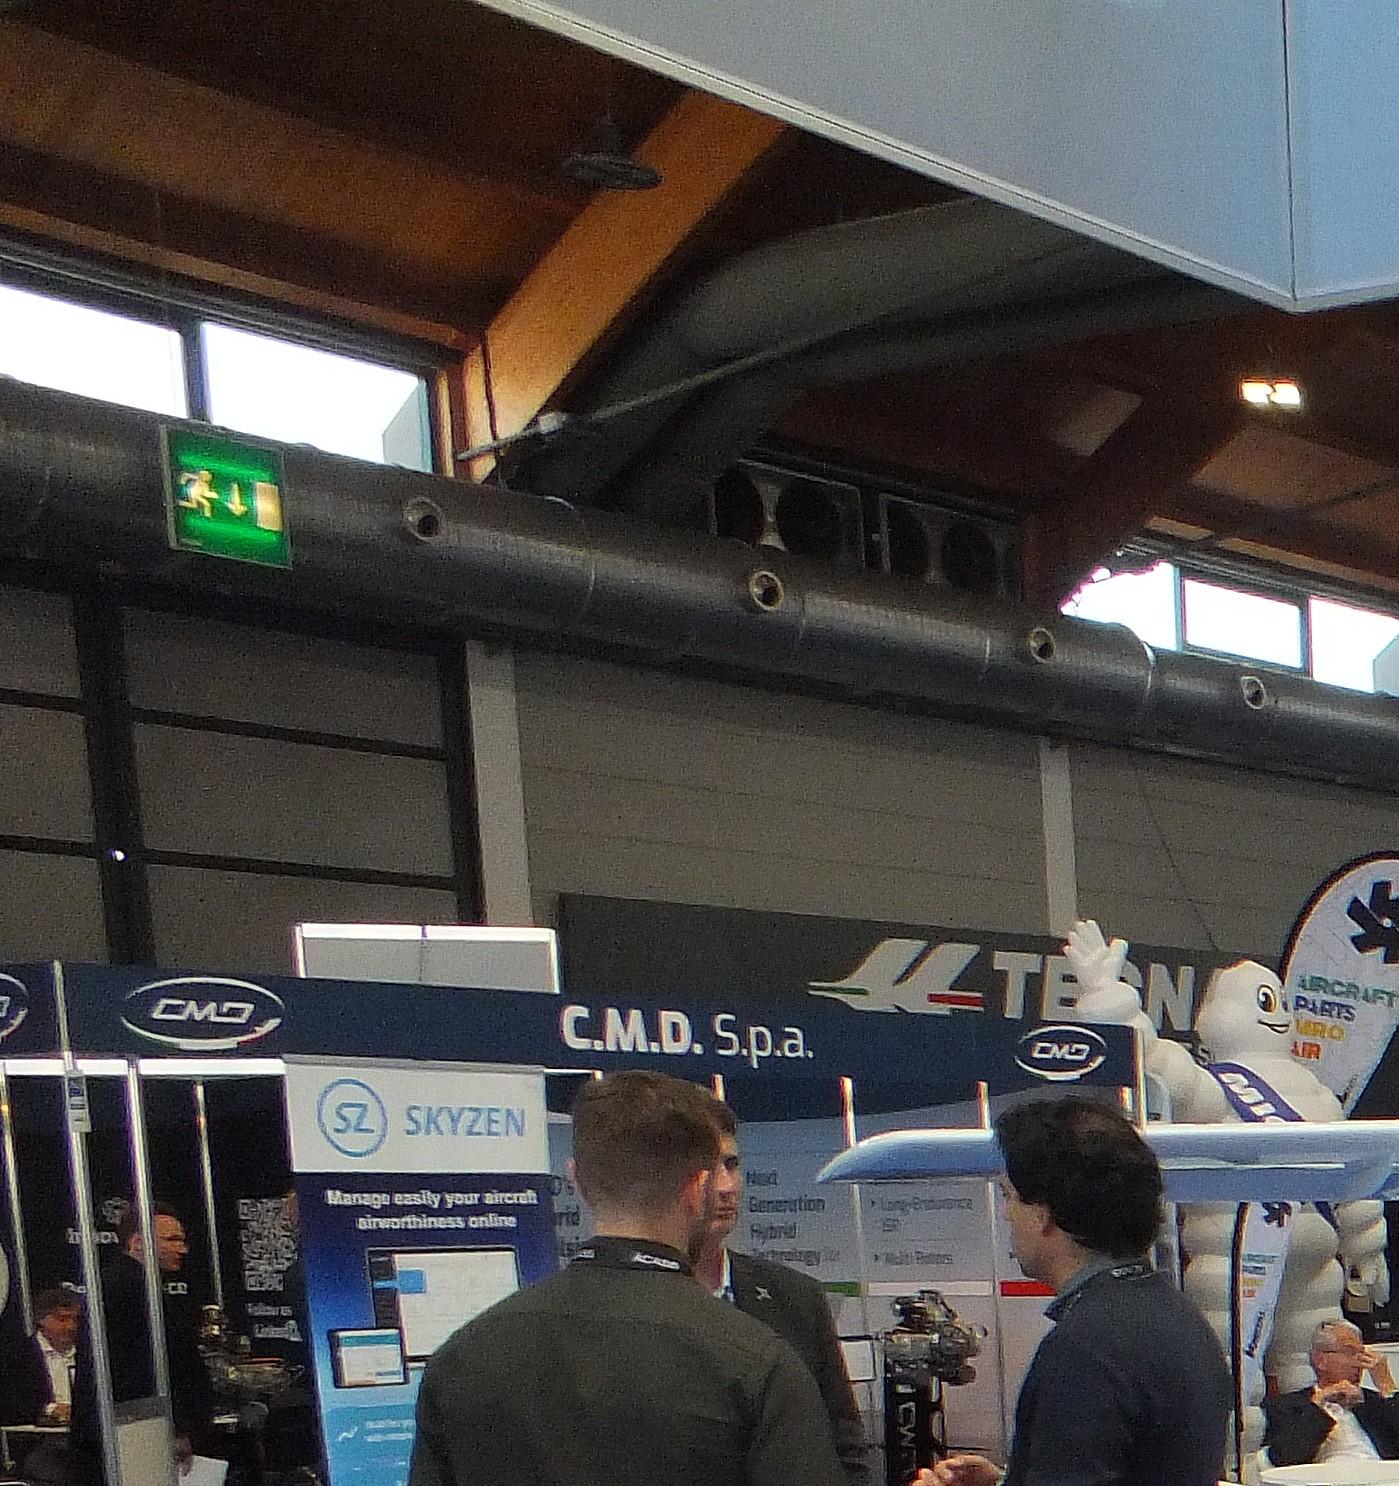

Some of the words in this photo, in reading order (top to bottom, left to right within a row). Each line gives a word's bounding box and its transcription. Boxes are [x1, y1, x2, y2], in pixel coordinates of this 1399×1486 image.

[993, 950, 1195, 1031] TEN
[561, 1005, 704, 1056] C.M.D.
[714, 1013, 813, 1069] S.p.a.
[405, 1104, 526, 1137] SKYZEN
[327, 1189, 390, 1209] Manage
[445, 1192, 480, 1208] your
[469, 1214, 518, 1228] online
